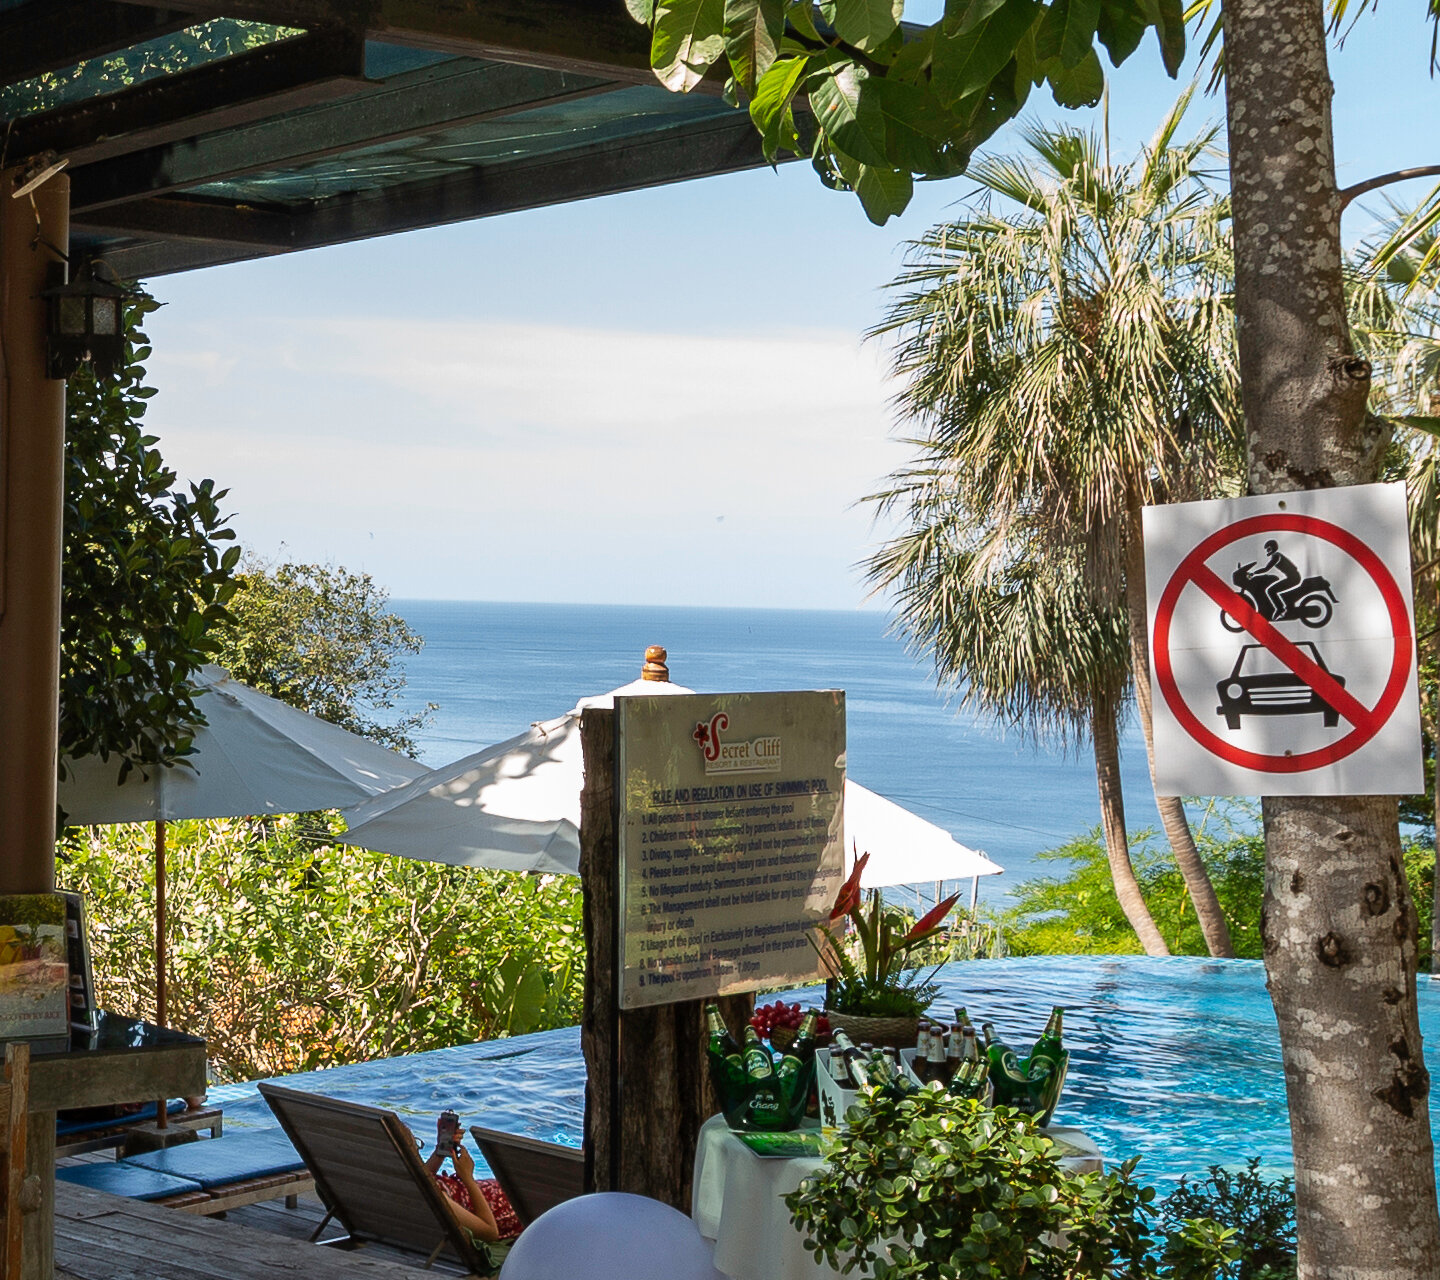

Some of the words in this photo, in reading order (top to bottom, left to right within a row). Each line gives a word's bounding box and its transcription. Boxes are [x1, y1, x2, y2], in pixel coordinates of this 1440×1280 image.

[705, 712, 749, 761] Secret
[754, 738, 780, 757] Cliff
[674, 787, 689, 802] AND
[692, 784, 734, 801] REGULATION
[736, 784, 746, 797] ON
[748, 782, 761, 796] USE
[764, 782, 773, 795] OF
[775, 779, 809, 794] SWIMMING
[811, 778, 828, 792] POOL
[647, 812, 656, 824] All
[658, 812, 684, 826] persons
[745, 803, 769, 818] entering
[770, 801, 780, 814] the
[781, 801, 794, 815] pool
[649, 829, 677, 842] Children
[745, 822, 753, 836] by
[748, 838, 761, 850] shall
[763, 838, 773, 849] not
[773, 837, 781, 847] be
[649, 864, 671, 879] Please
[672, 863, 688, 876] leave
[690, 862, 700, 874] the
[701, 860, 715, 876] pool
[717, 859, 735, 874] during
[736, 858, 753, 872] heavy
[755, 855, 766, 867] rain
[767, 854, 778, 866] and
[779, 850, 817, 864] thunderstorm
[649, 885, 658, 896] No
[659, 881, 688, 898] lifeguard
[713, 876, 745, 890] Swimmers
[746, 874, 761, 886] swim
[763, 873, 768, 883] at
[769, 873, 780, 883] own
[648, 901, 661, 914] The
[662, 897, 704, 915] Management
[720, 894, 731, 906] not
[731, 892, 739, 905] be
[740, 891, 754, 904] hold
[755, 889, 770, 901] liable
[771, 888, 779, 899] for
[780, 889, 791, 901] any
[667, 920, 674, 930] or
[675, 915, 694, 929] death
[668, 935, 675, 947] of
[676, 934, 686, 946] the
[687, 932, 702, 947] pool
[711, 927, 743, 944] Exclusively
[744, 926, 752, 937] for
[754, 922, 785, 939] Registered
[785, 919, 799, 932] hotel
[683, 949, 698, 962] food
[712, 945, 740, 961] Beverage
[742, 941, 764, 955] allowed
[771, 939, 781, 950] the
[781, 937, 794, 952] pool
[795, 937, 807, 947] area
[749, 1099, 779, 1111] Chang
